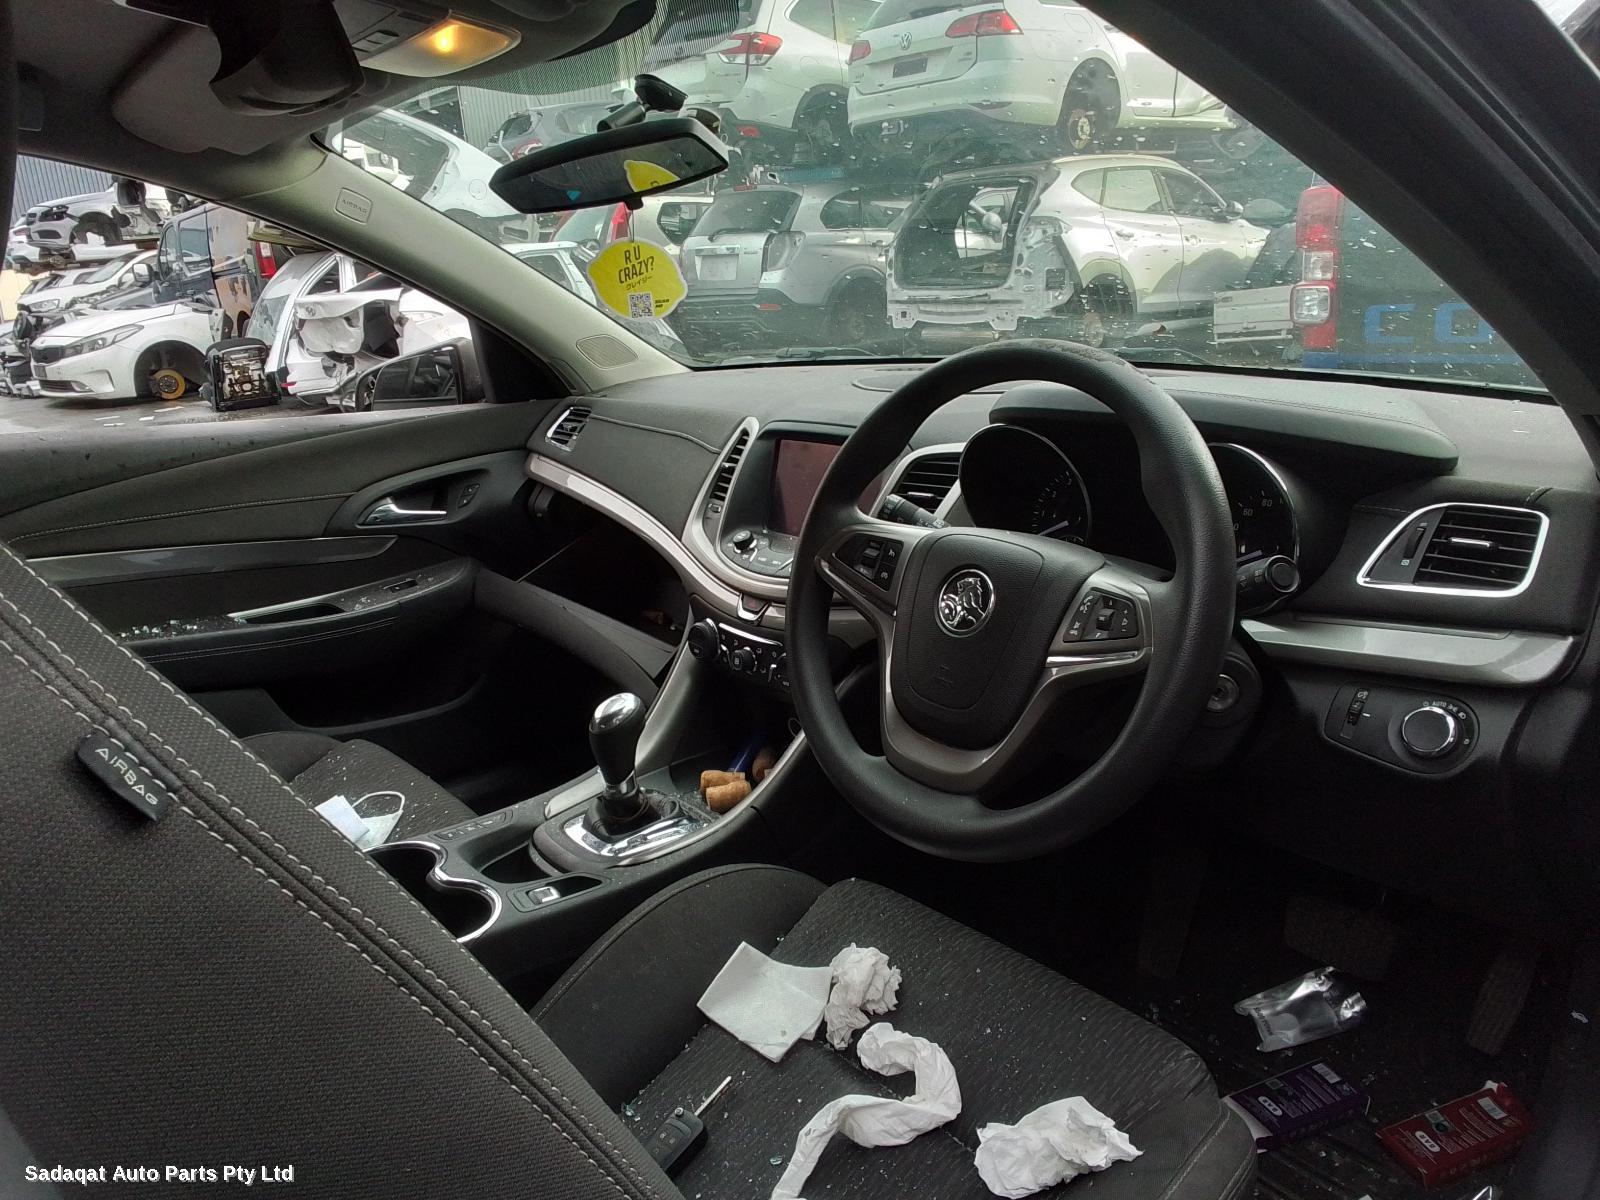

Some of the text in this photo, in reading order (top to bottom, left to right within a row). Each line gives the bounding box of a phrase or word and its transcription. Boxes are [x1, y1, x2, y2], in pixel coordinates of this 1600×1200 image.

[624, 245, 641, 265] R U
[618, 256, 655, 284] CRAZY?
[94, 748, 158, 805] AIRBAG
